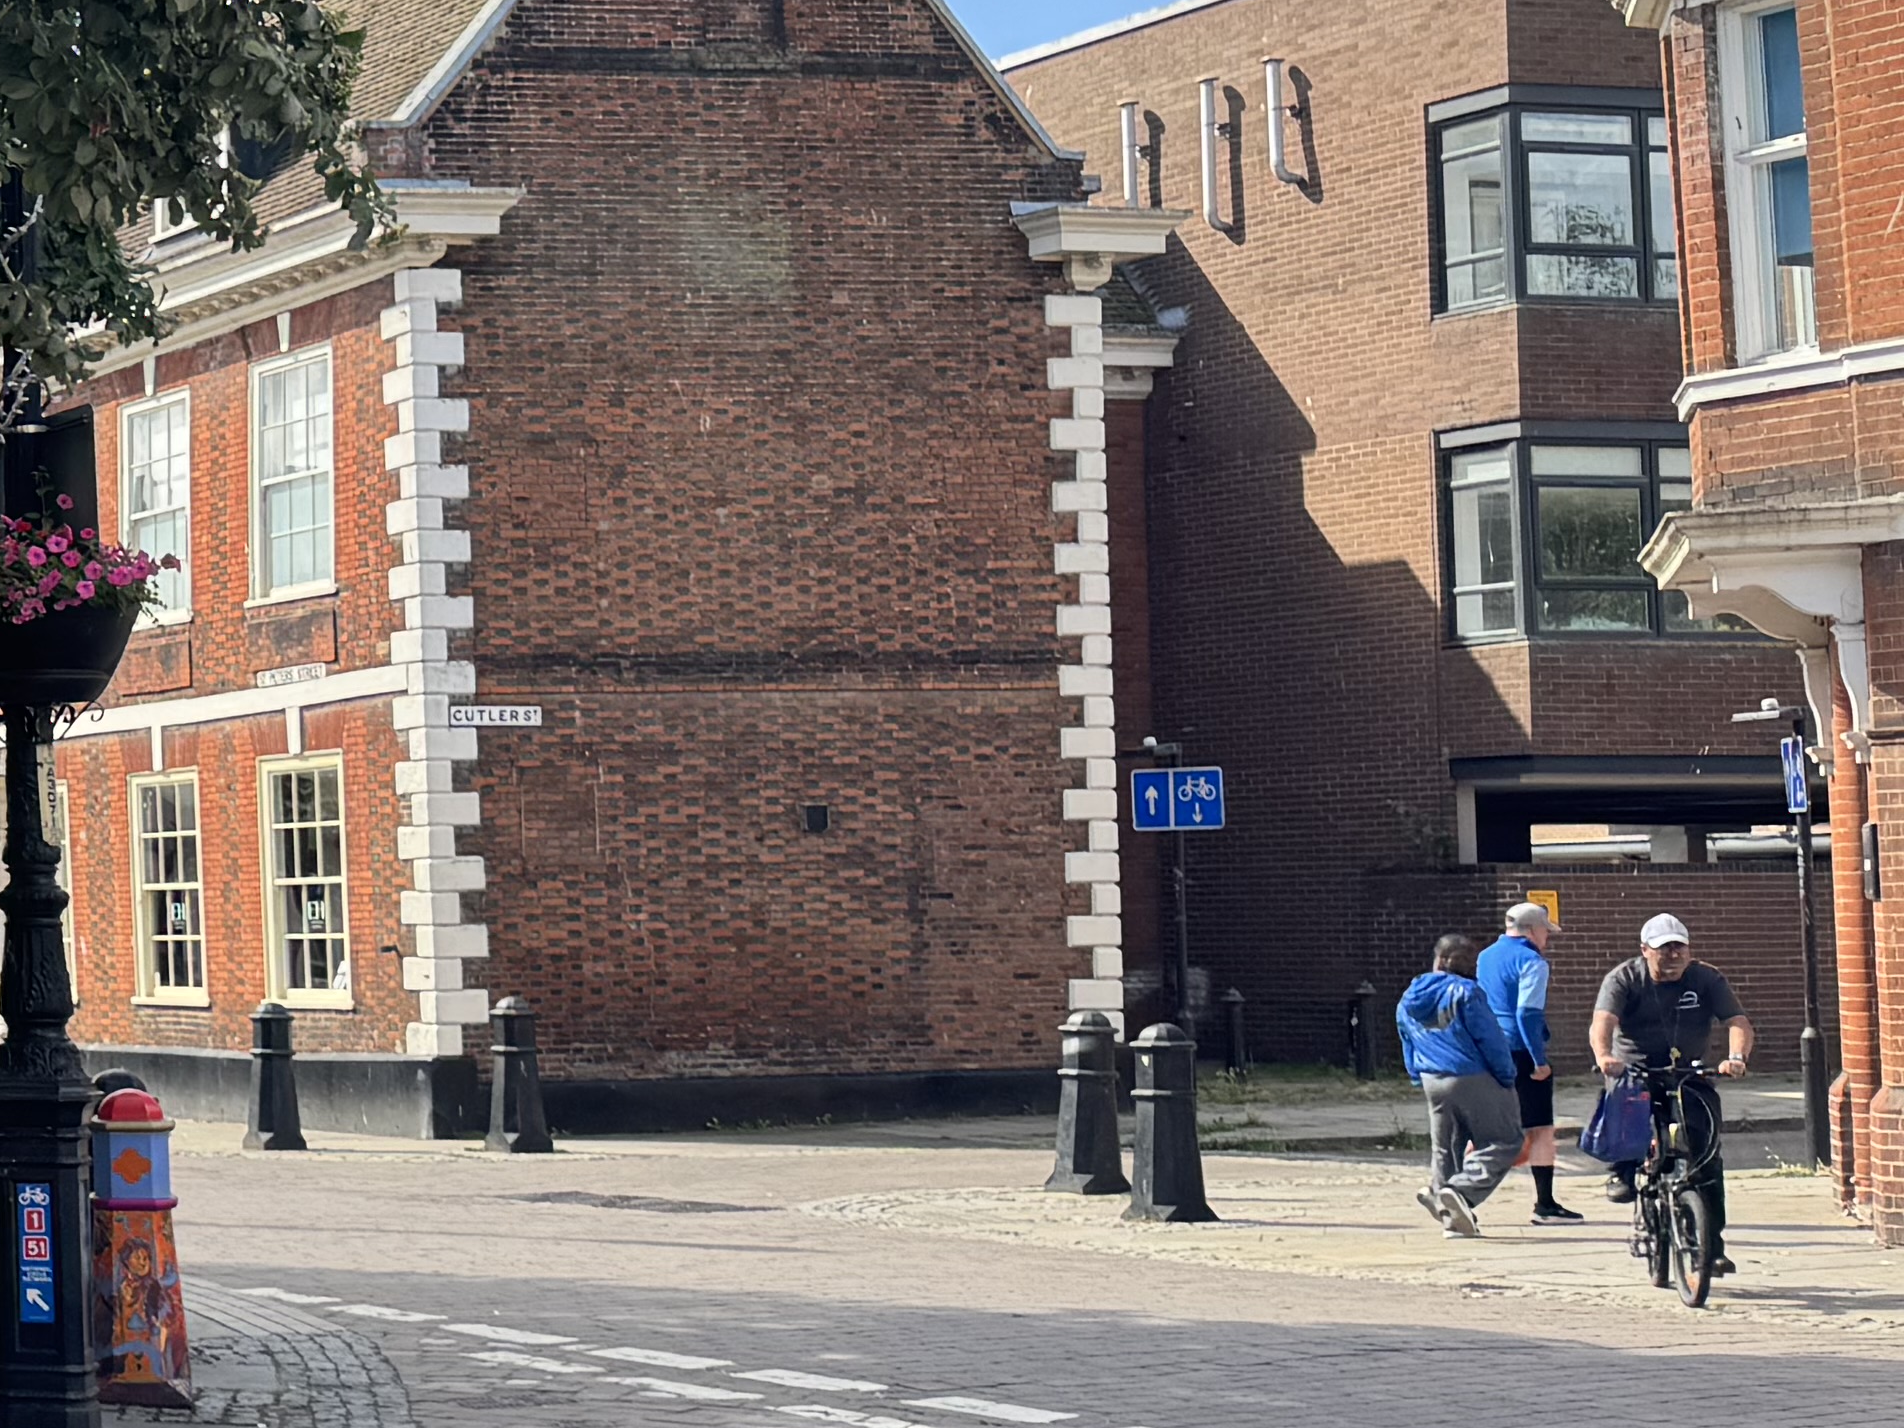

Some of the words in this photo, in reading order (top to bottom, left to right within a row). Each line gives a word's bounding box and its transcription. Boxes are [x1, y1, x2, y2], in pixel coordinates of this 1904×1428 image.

[453, 709, 519, 722] CUTLER
[31, 1212, 39, 1228] 1
[27, 1240, 45, 1256] 51
